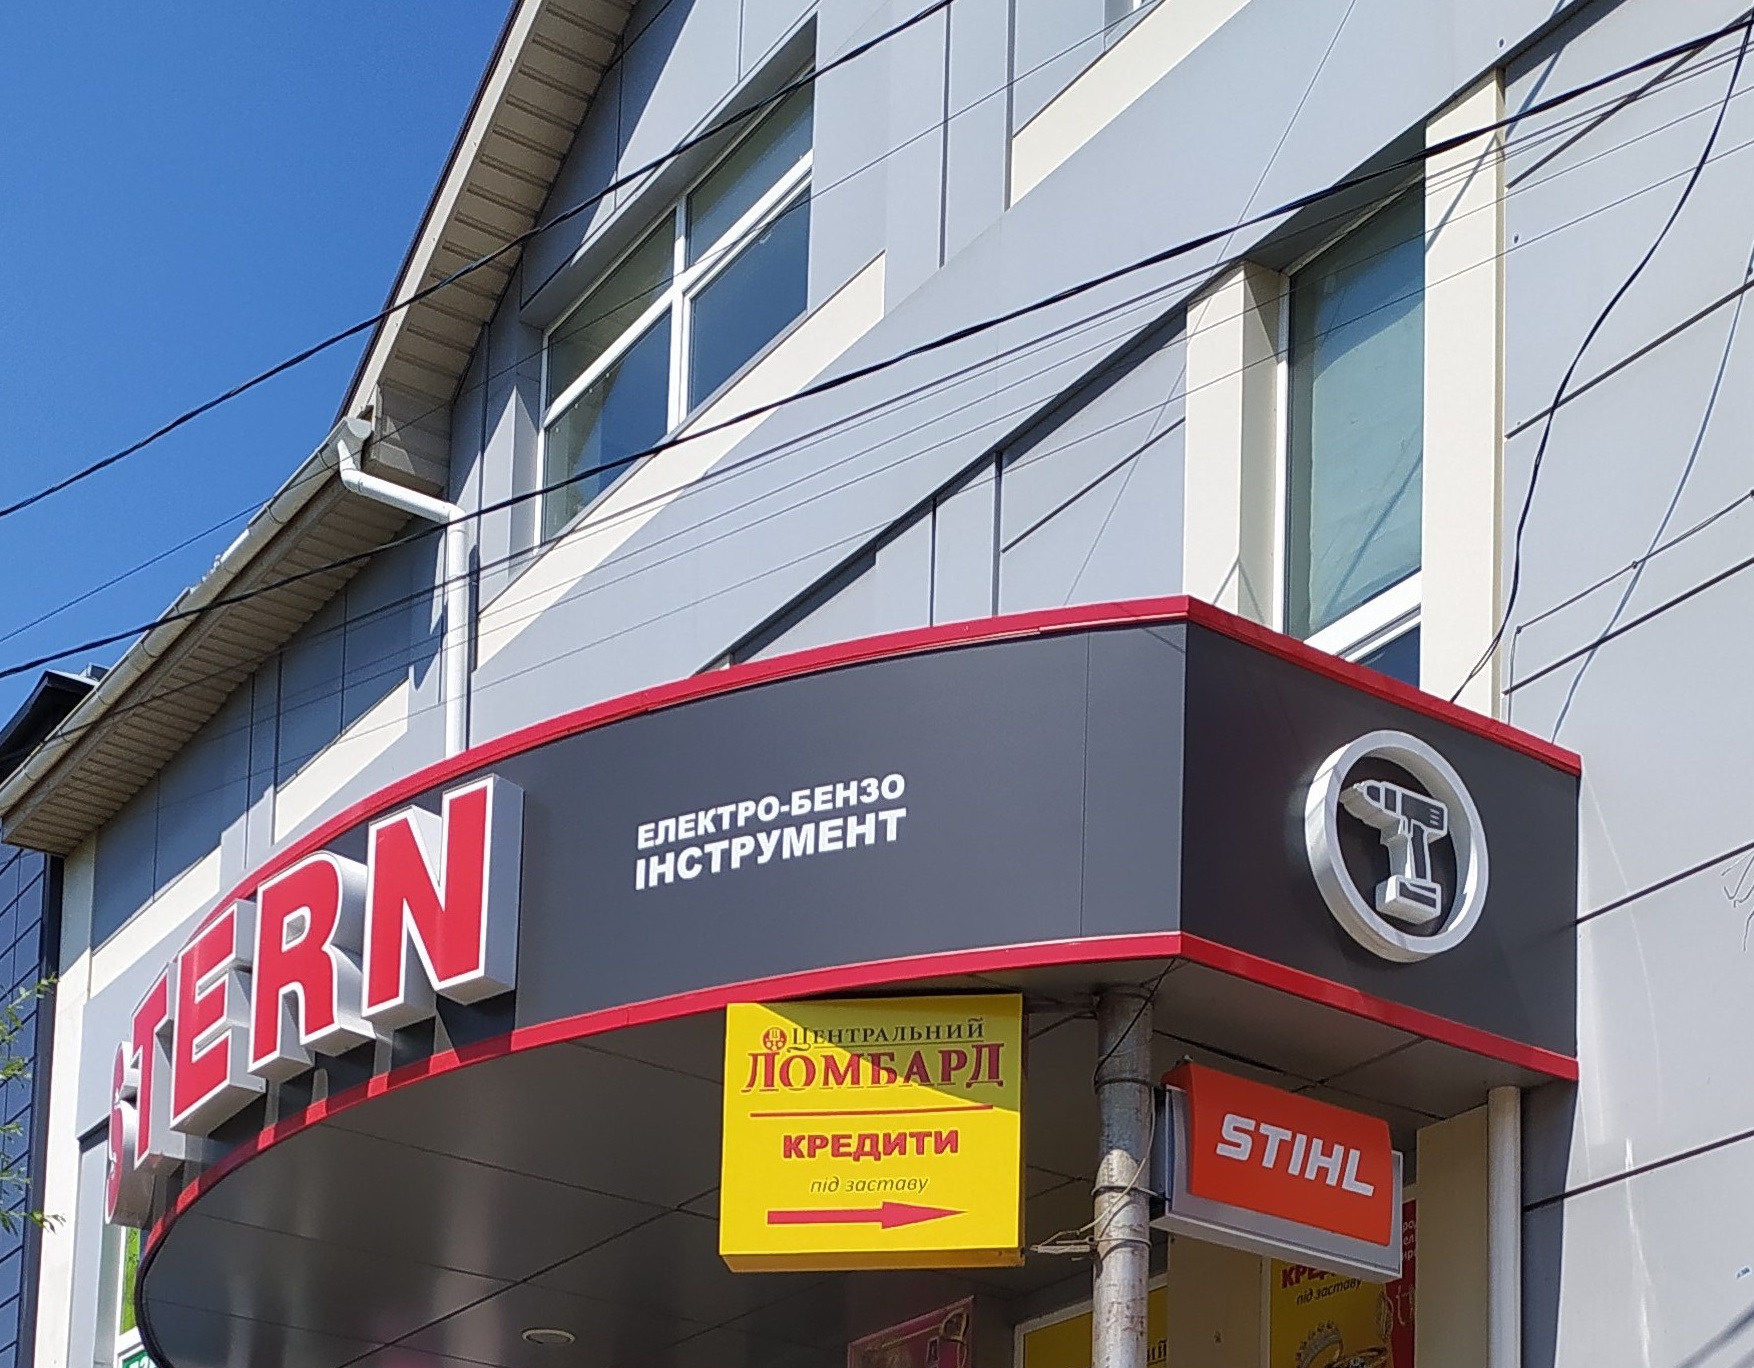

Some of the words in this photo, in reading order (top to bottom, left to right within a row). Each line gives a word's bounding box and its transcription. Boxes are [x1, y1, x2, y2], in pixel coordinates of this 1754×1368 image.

[637, 774, 905, 850] ЕЛЕКТРО-БЕНЗО
[635, 808, 907, 890] ІНСТРУМЕНТ
[105, 773, 522, 1225] STERN
[787, 1017, 985, 1051] ЦЕНТРАЛЬНИЙ
[741, 1043, 1005, 1092] ЛОМБАРД
[783, 1130, 958, 1162] КРЕДИТИ
[1216, 1113, 1374, 1197] STIHL
[810, 1176, 839, 1193] під
[845, 1177, 928, 1193] заставу
[1297, 1288, 1314, 1306] під
[1316, 1278, 1362, 1300] заставу
